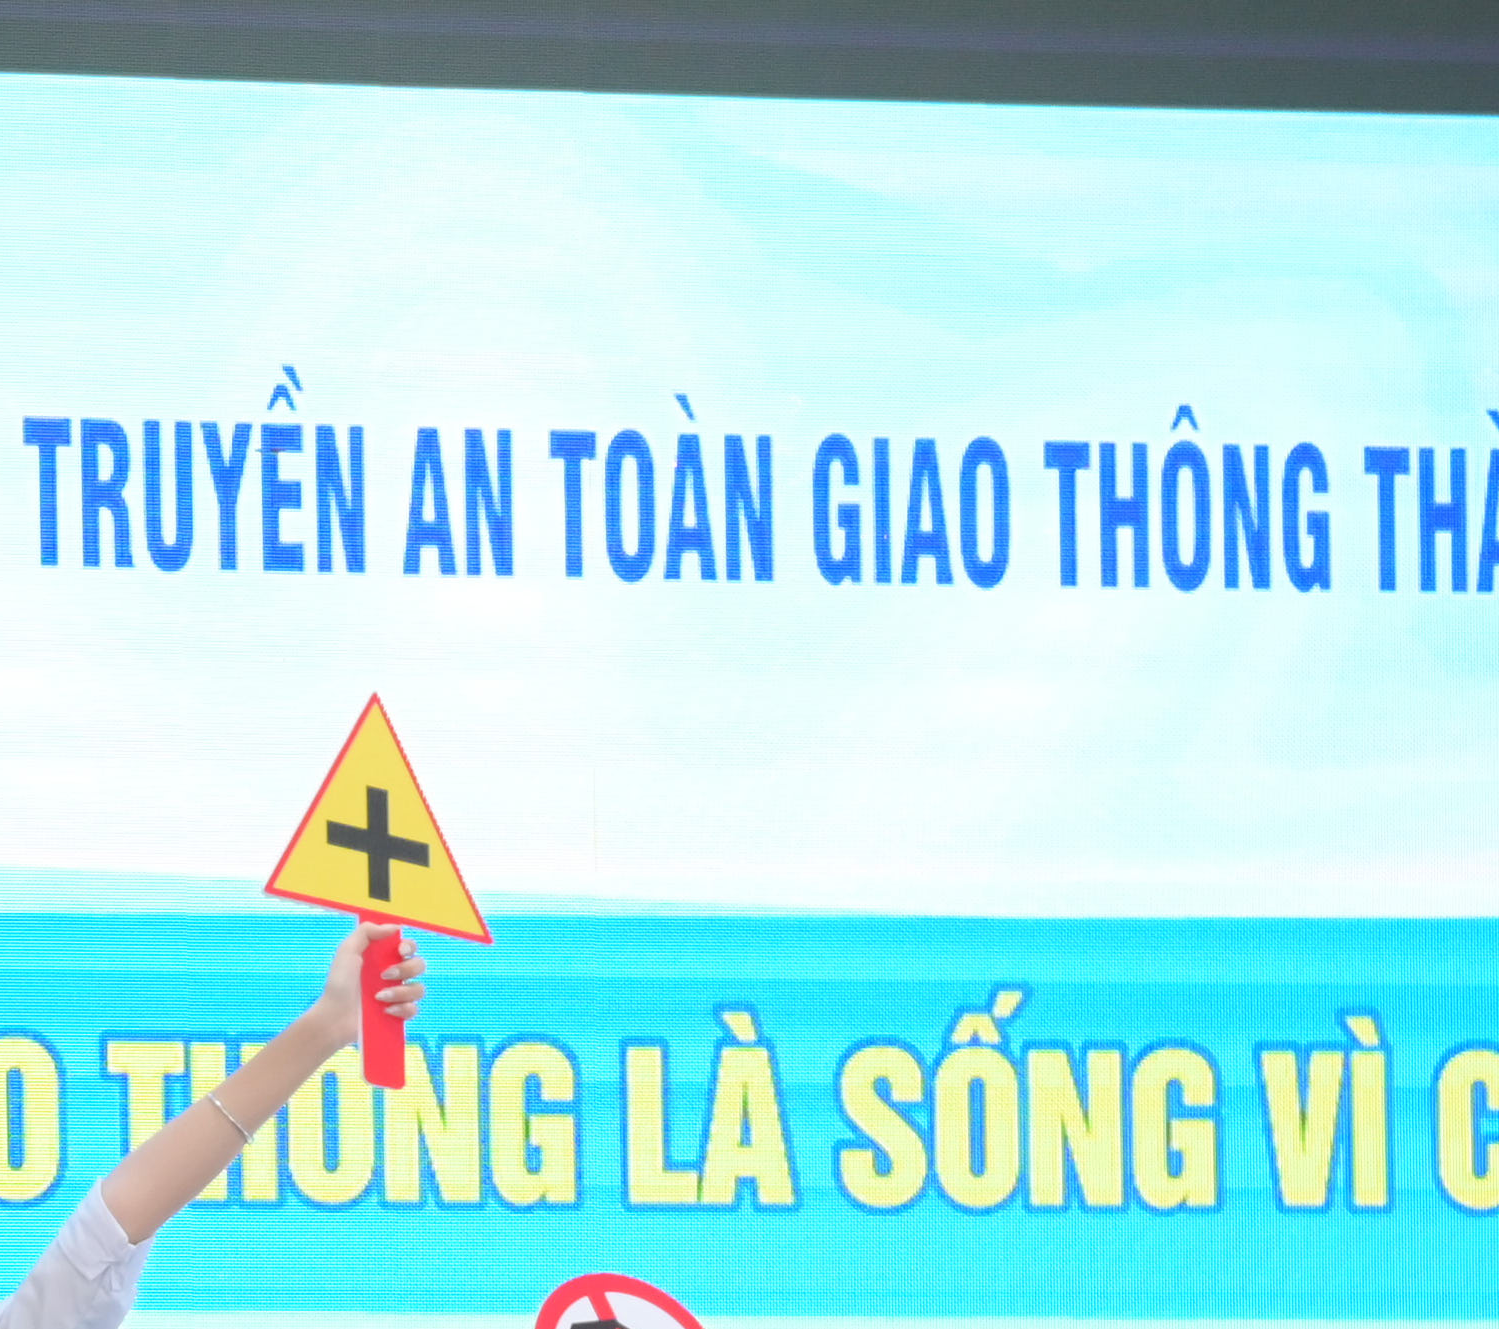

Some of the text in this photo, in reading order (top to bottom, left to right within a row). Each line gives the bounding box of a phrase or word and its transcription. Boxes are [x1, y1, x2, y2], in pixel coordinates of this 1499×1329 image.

[22, 364, 367, 575] TRUYỀN
[402, 427, 515, 577] AN
[549, 393, 775, 584] TOÀN
[811, 433, 1012, 591] GIAO
[1042, 403, 1333, 595] THÔNG
[626, 1010, 795, 1207] LÀ
[839, 990, 1219, 1211] SỐNG
[1260, 1014, 1390, 1208] VÌ
